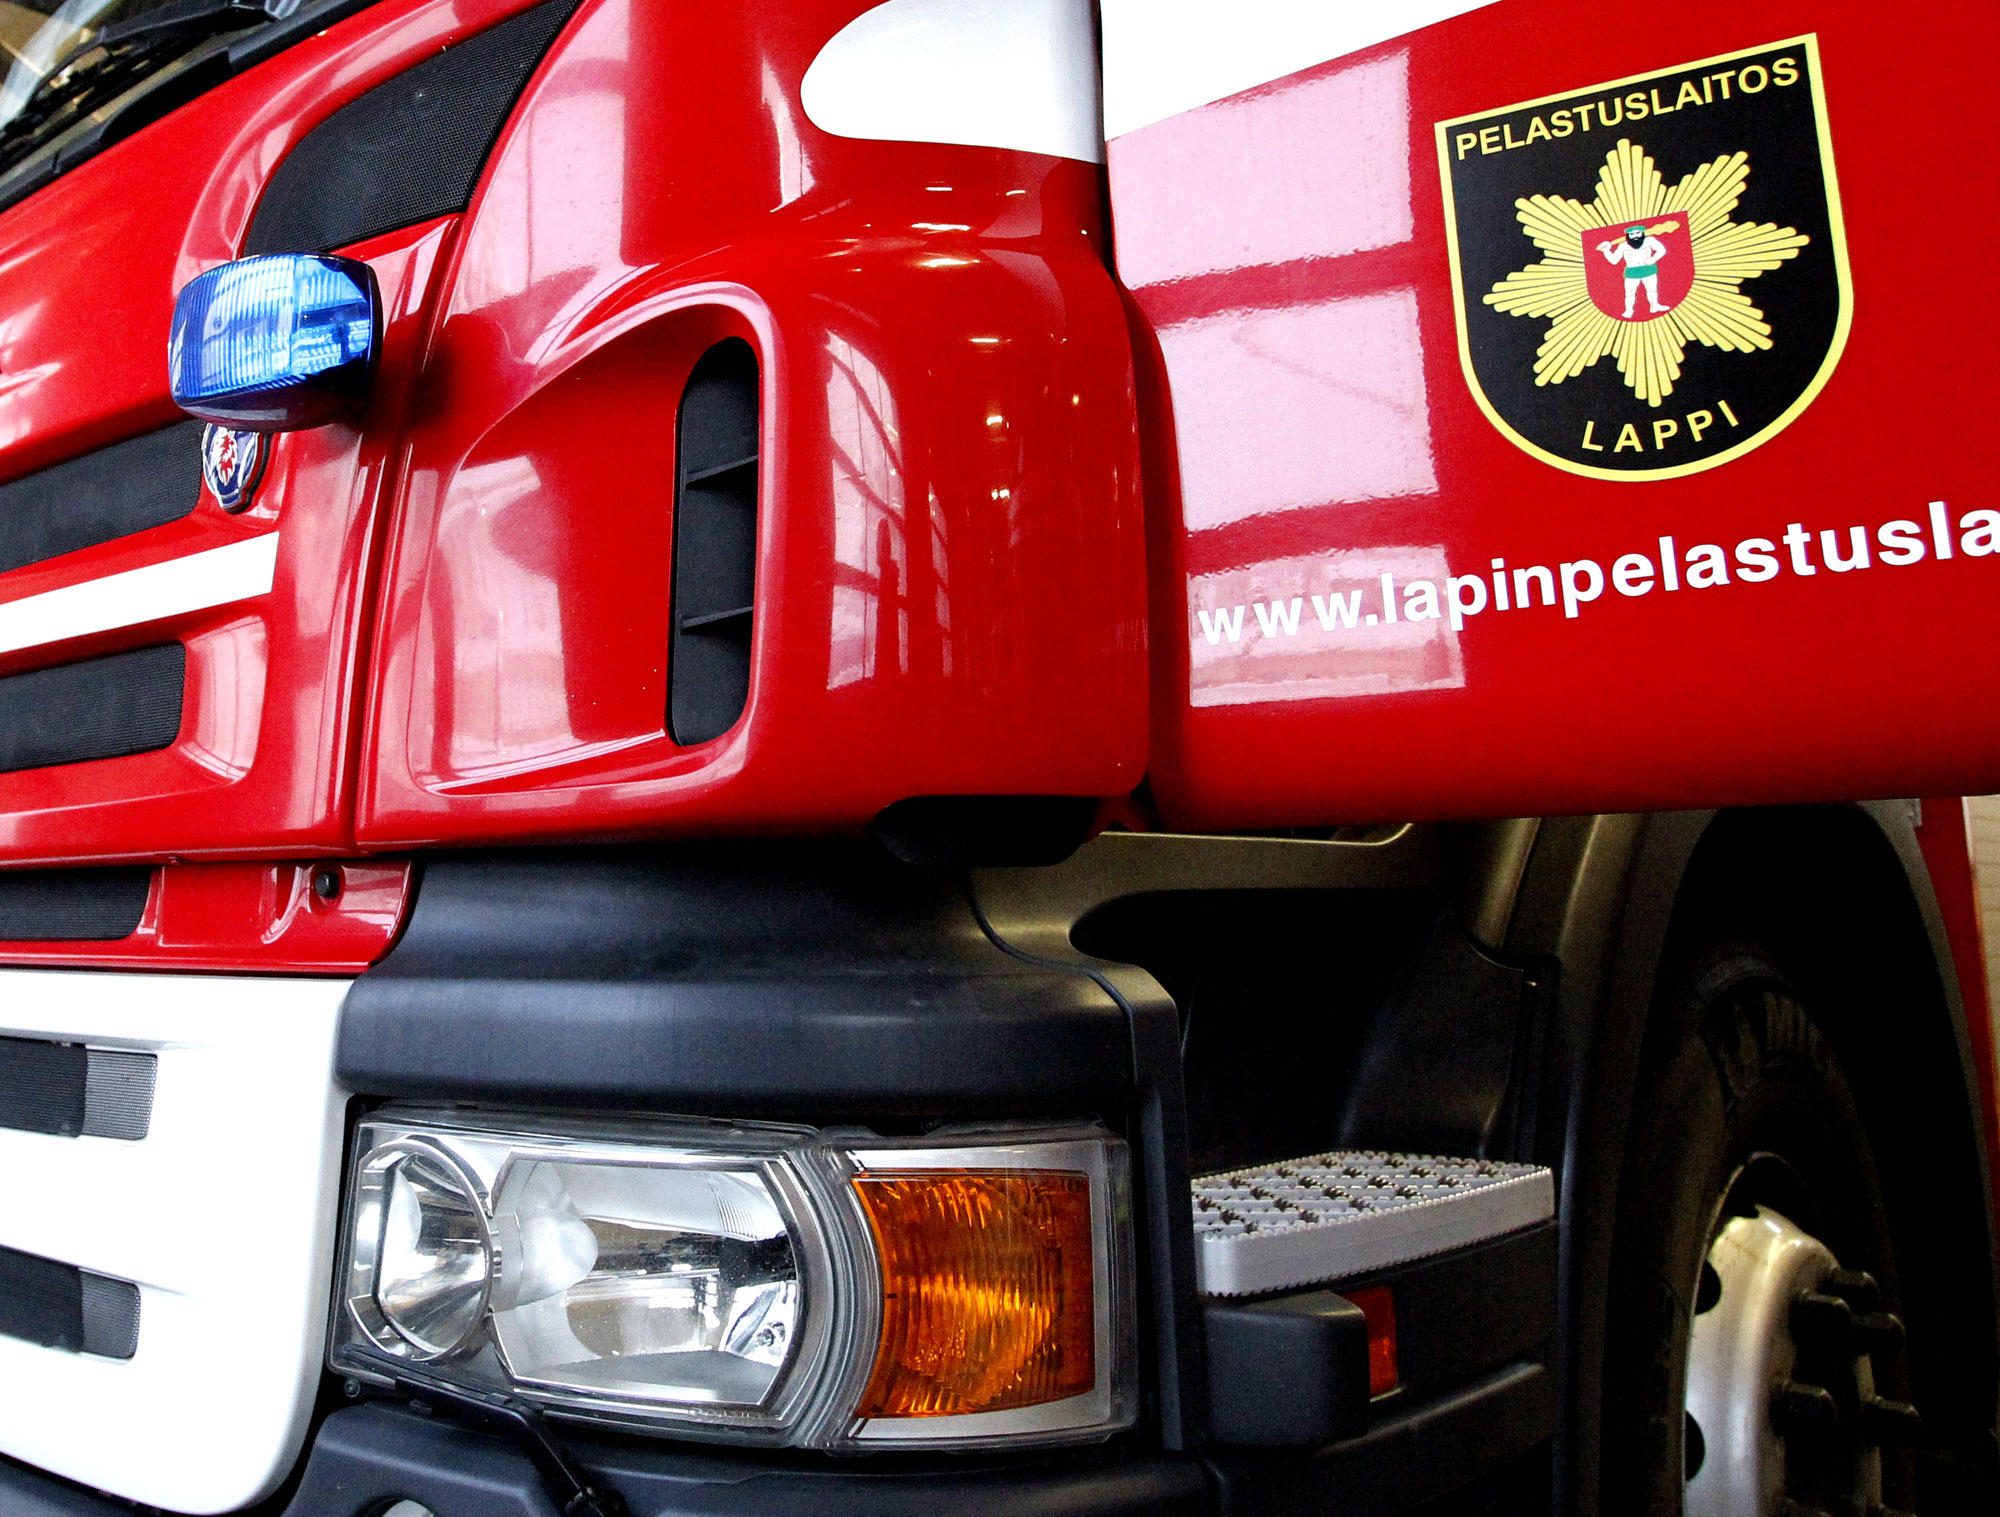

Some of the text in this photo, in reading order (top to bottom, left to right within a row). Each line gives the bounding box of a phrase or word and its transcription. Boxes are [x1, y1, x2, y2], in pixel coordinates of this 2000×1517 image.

[1455, 57, 1799, 161] PELASTUSLAITOS
[1581, 399, 1739, 453] LAPPI
[1197, 501, 2000, 646] www.lapinpelastusla
